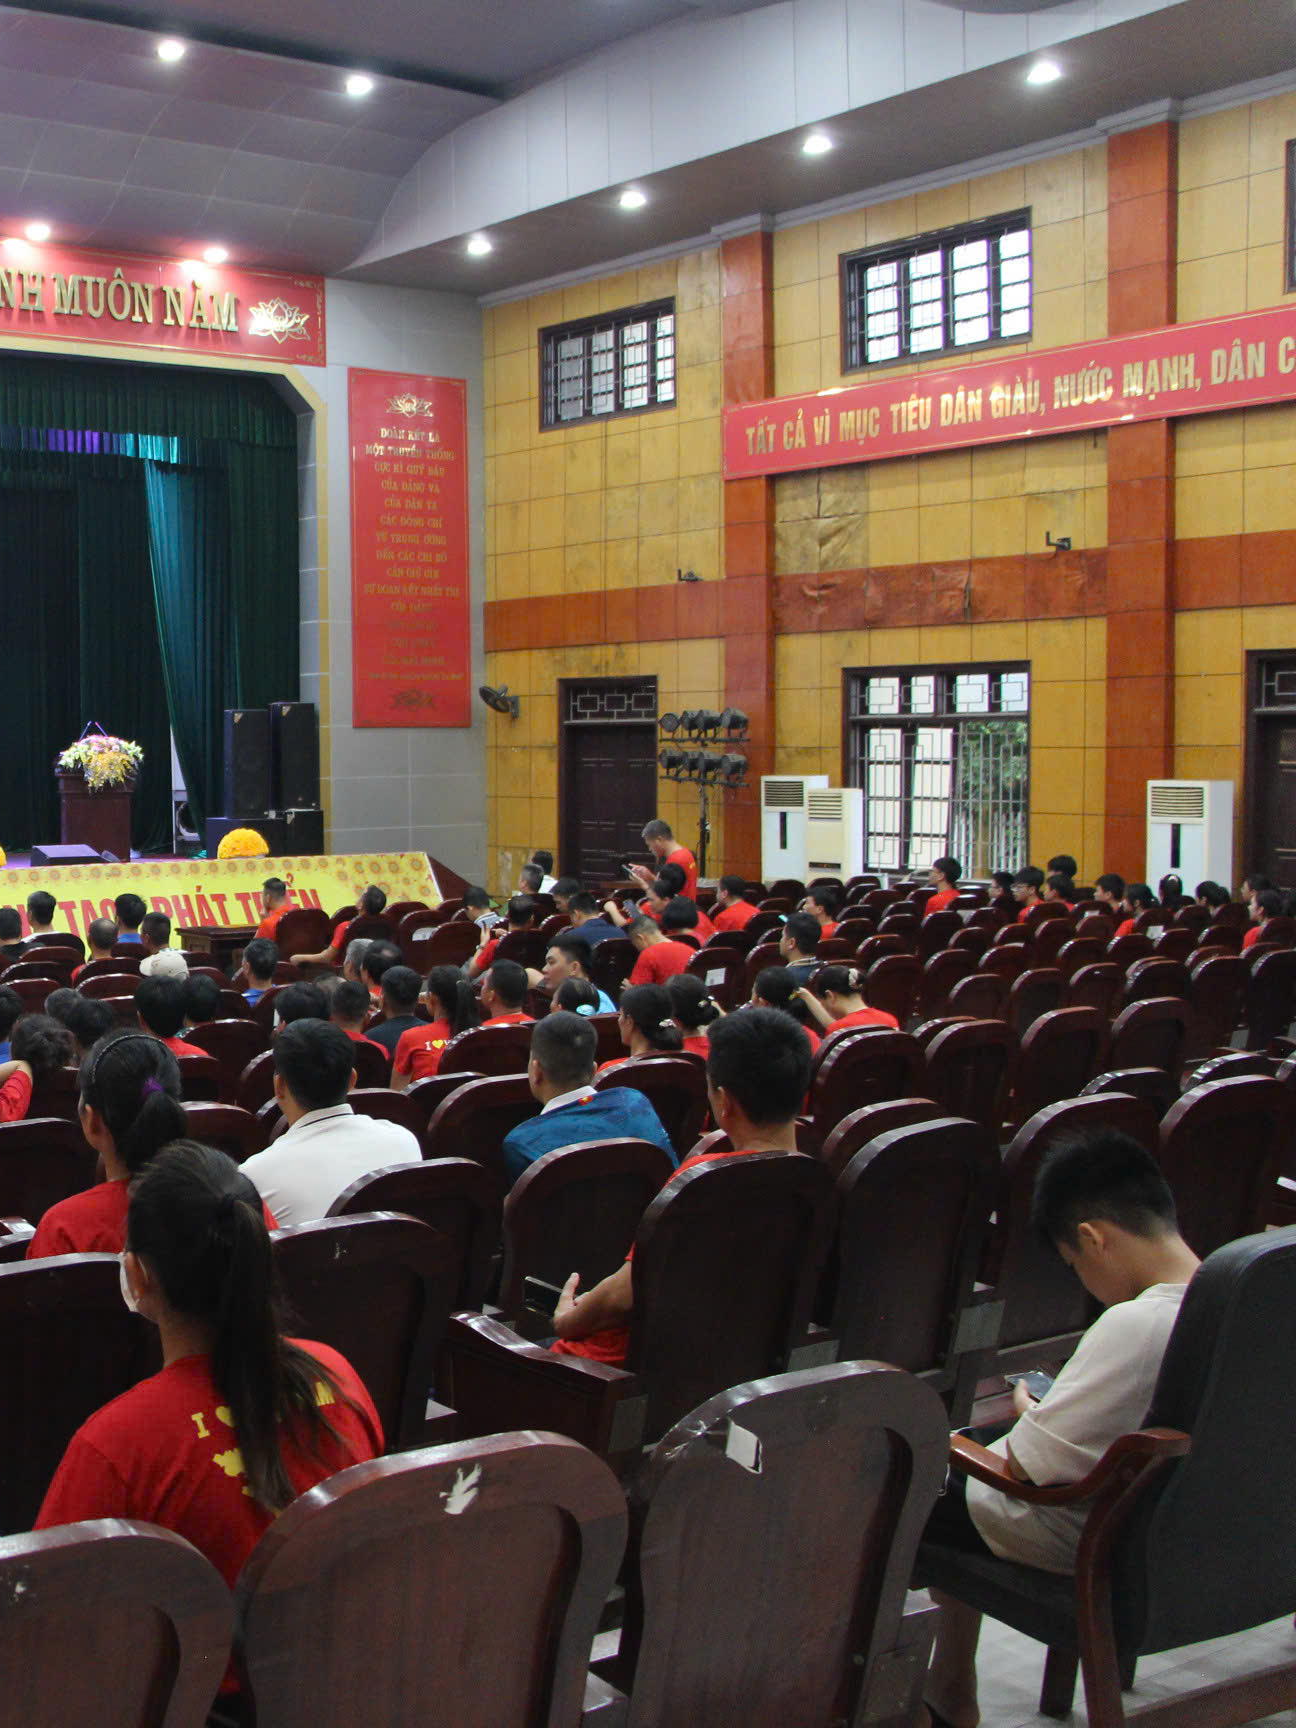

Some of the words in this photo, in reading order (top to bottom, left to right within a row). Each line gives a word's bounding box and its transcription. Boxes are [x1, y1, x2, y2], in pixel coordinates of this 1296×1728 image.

[52, 267, 155, 325] MUÔN
[162, 279, 239, 333] NĂM
[745, 416, 776, 456] TẤT
[783, 408, 806, 450] CẢ
[813, 409, 831, 446] VÌ
[839, 407, 880, 445] MỤC
[890, 393, 932, 434] TIÊU
[939, 384, 982, 427] DÂN
[1053, 360, 1113, 409] NƯỚC
[1122, 353, 1201, 400] MẠNH,
[1210, 338, 1265, 385] DÂN
[150, 885, 230, 928] PHÁT
